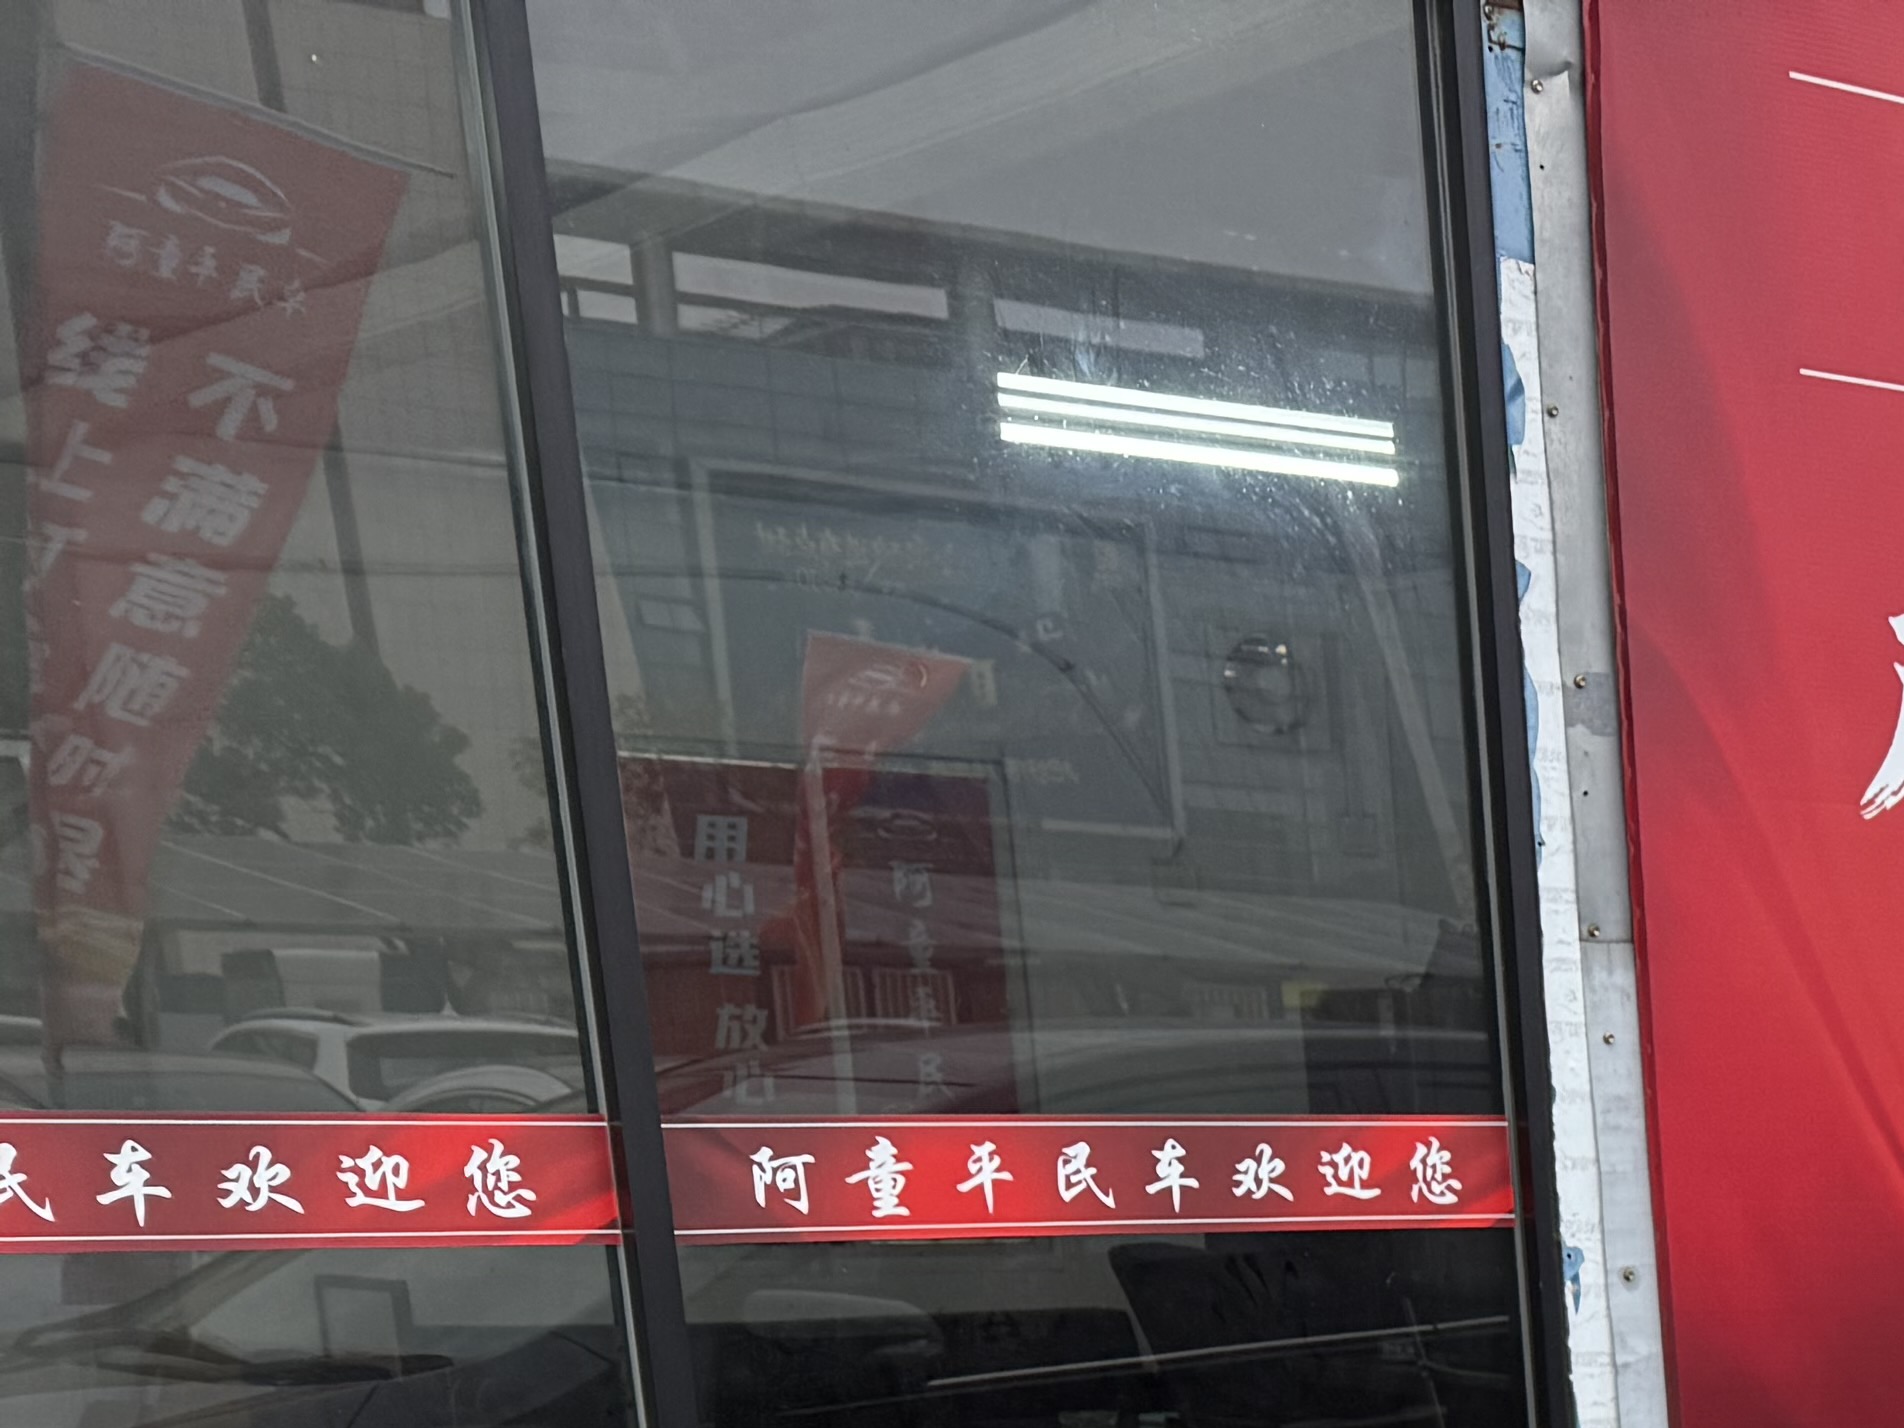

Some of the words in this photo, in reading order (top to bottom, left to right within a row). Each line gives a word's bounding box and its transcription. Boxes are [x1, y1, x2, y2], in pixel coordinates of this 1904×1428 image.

[748, 1136, 1463, 1217] 阿童平民车欢迎您
